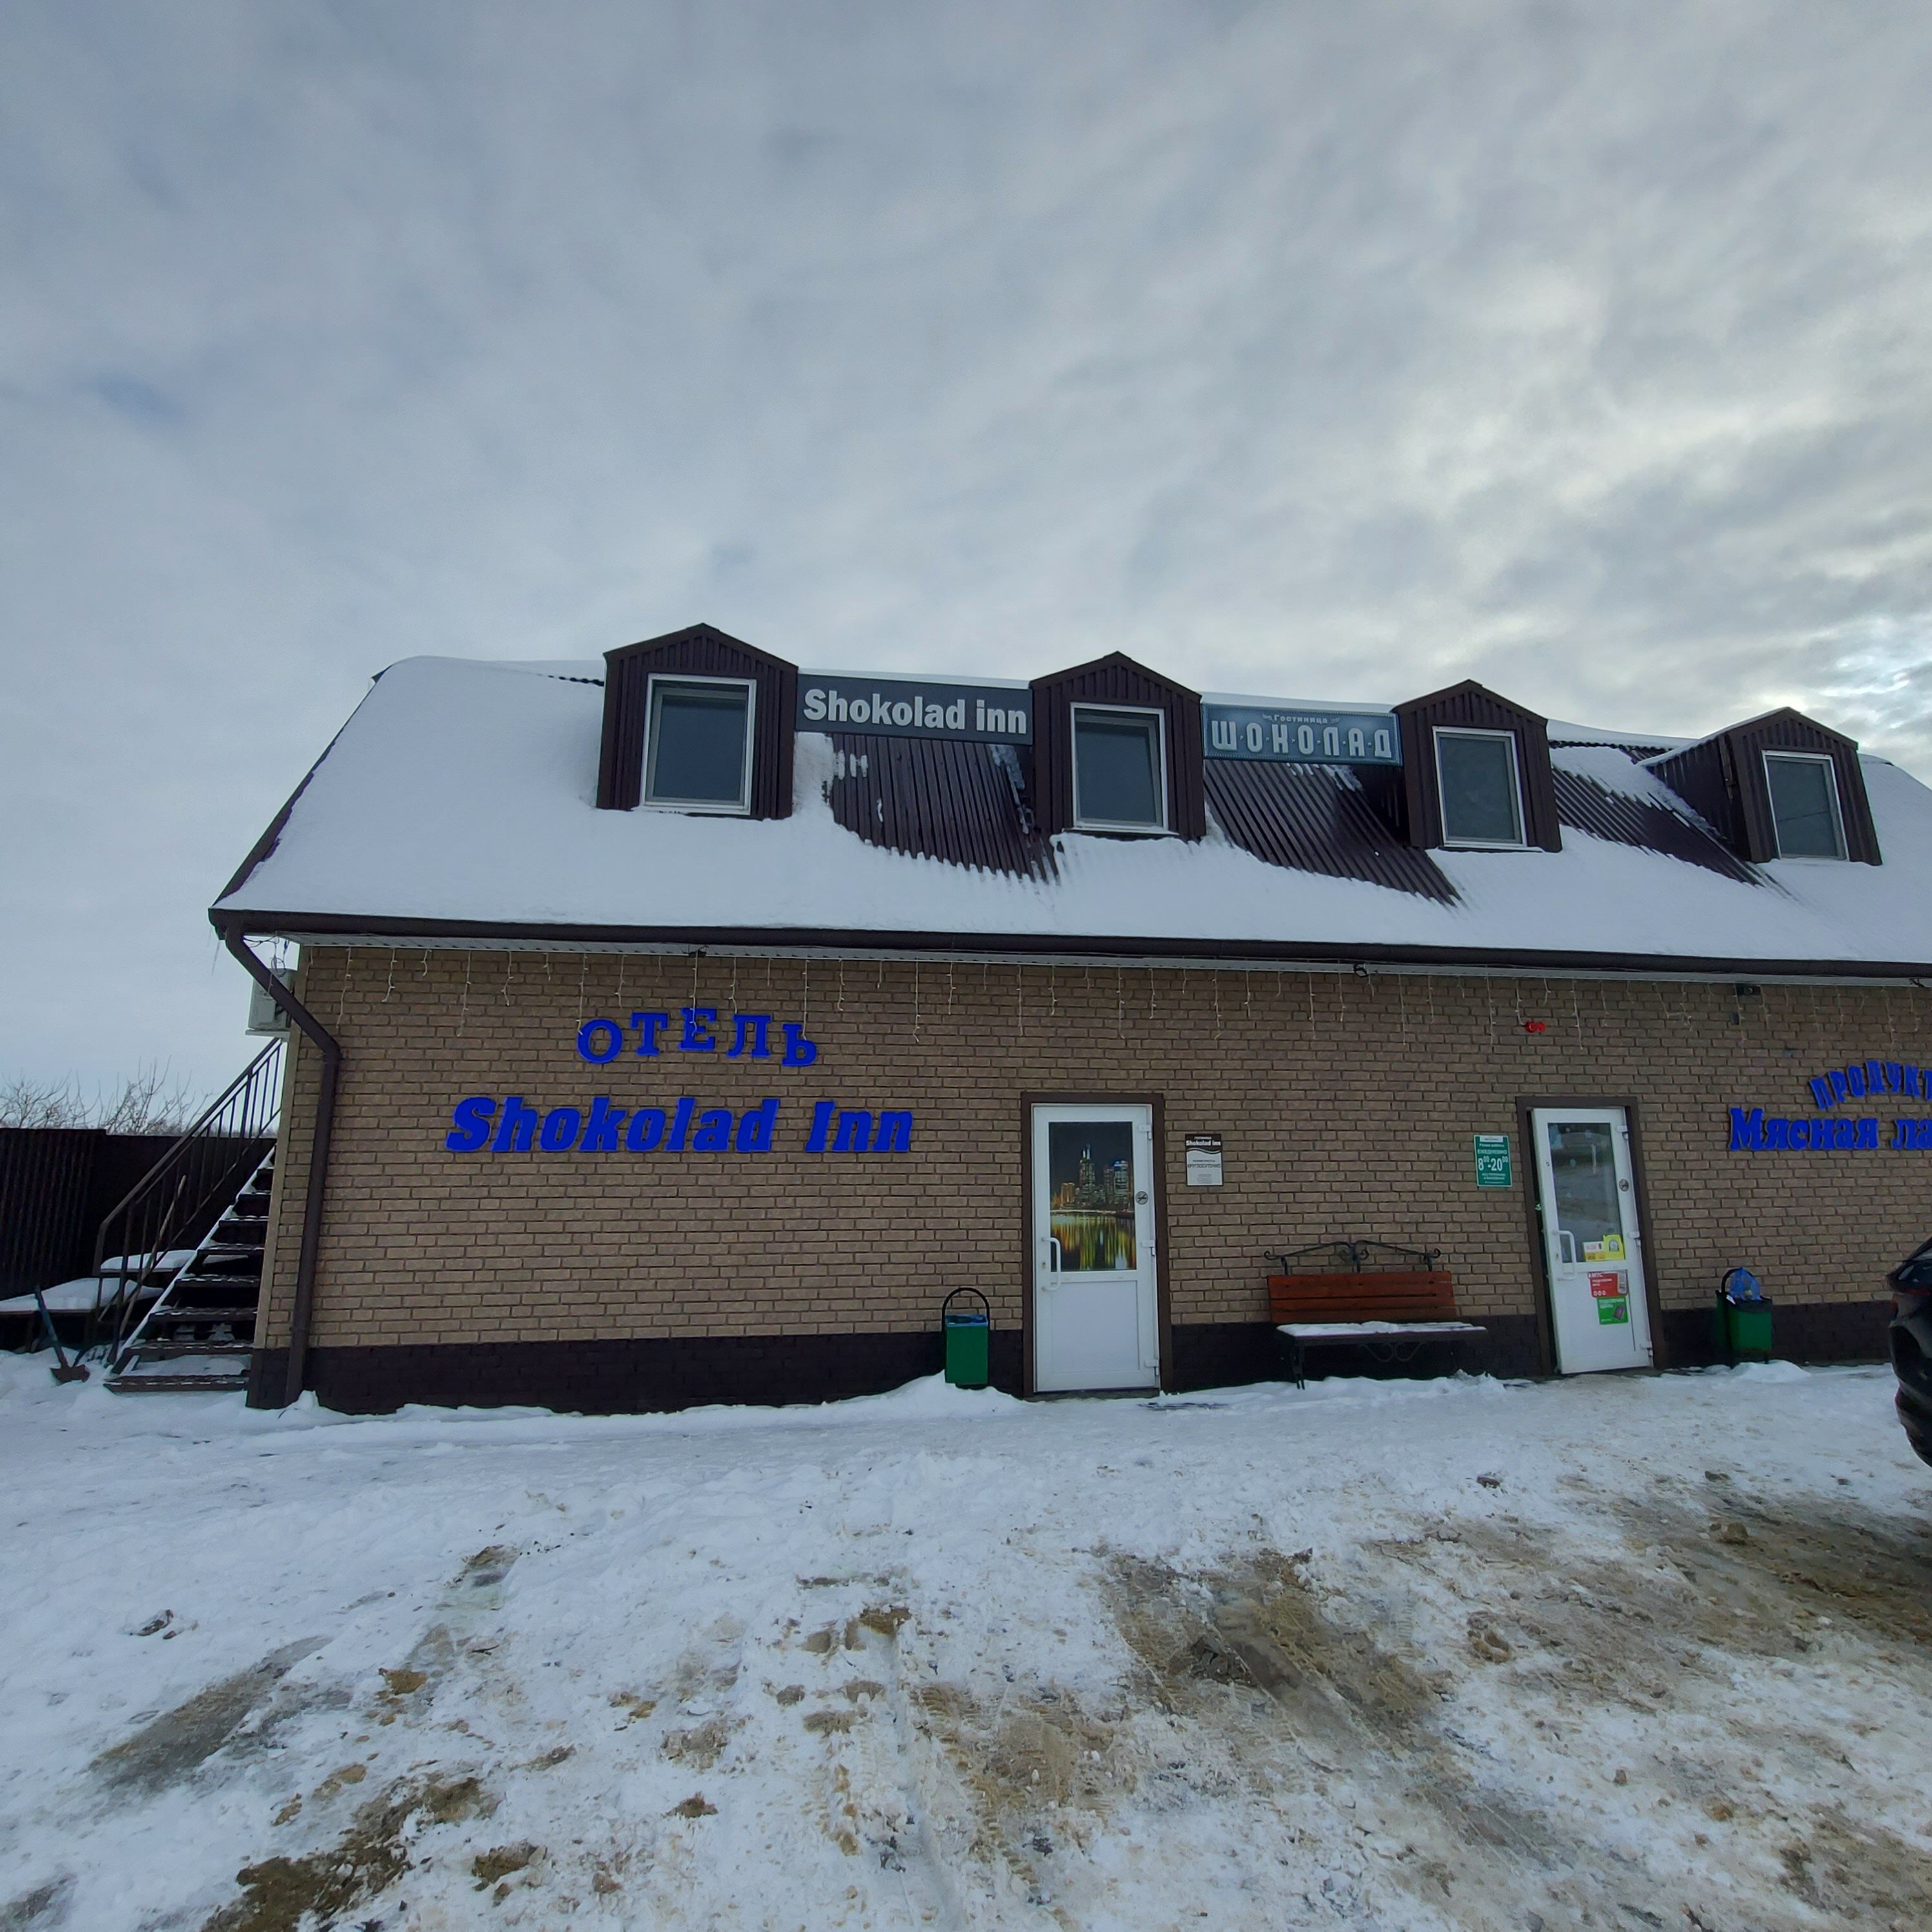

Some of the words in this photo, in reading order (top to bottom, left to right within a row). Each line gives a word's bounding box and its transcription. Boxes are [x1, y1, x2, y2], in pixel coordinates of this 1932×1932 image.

[803, 688, 965, 730] Shokolad
[976, 699, 1027, 734] inn
[1273, 714, 1328, 725] Гостиница
[577, 1008, 817, 1067] ОТЕЛЬ
[446, 1096, 780, 1153] Shokolad
[805, 1101, 914, 1153] Inn
[1728, 1107, 1879, 1151] Мясная
